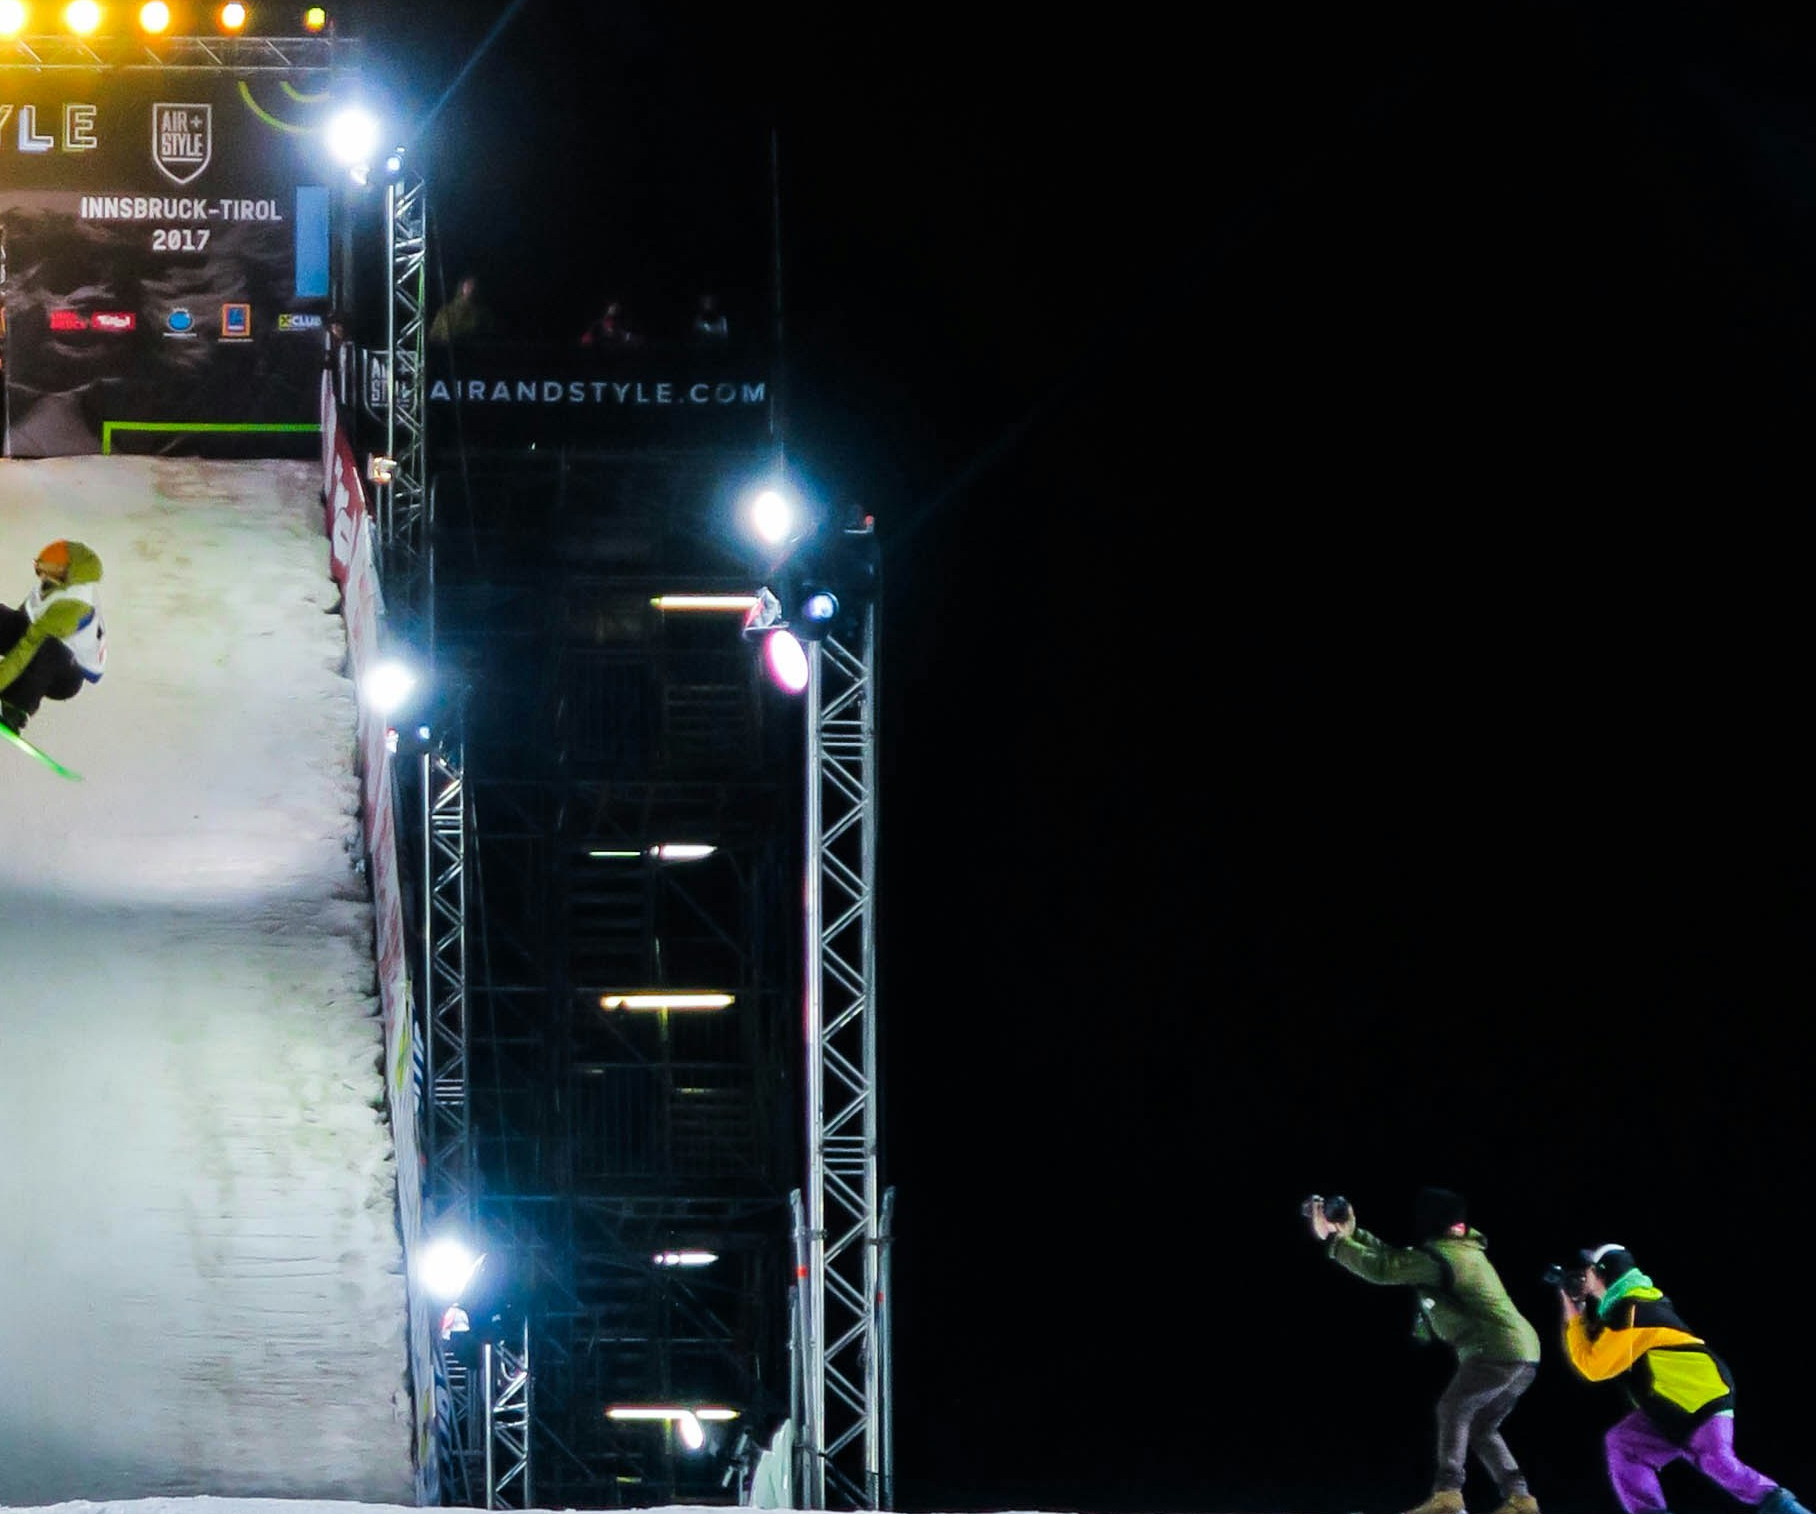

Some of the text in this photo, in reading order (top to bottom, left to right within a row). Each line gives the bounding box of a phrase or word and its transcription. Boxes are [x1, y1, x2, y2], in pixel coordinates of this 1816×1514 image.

[161, 134, 204, 157] STYLE
[81, 198, 283, 222] INNSBRUCK-TIROL
[152, 230, 210, 251] 2017
[429, 380, 766, 404] AIRANDSTYLE.COM
